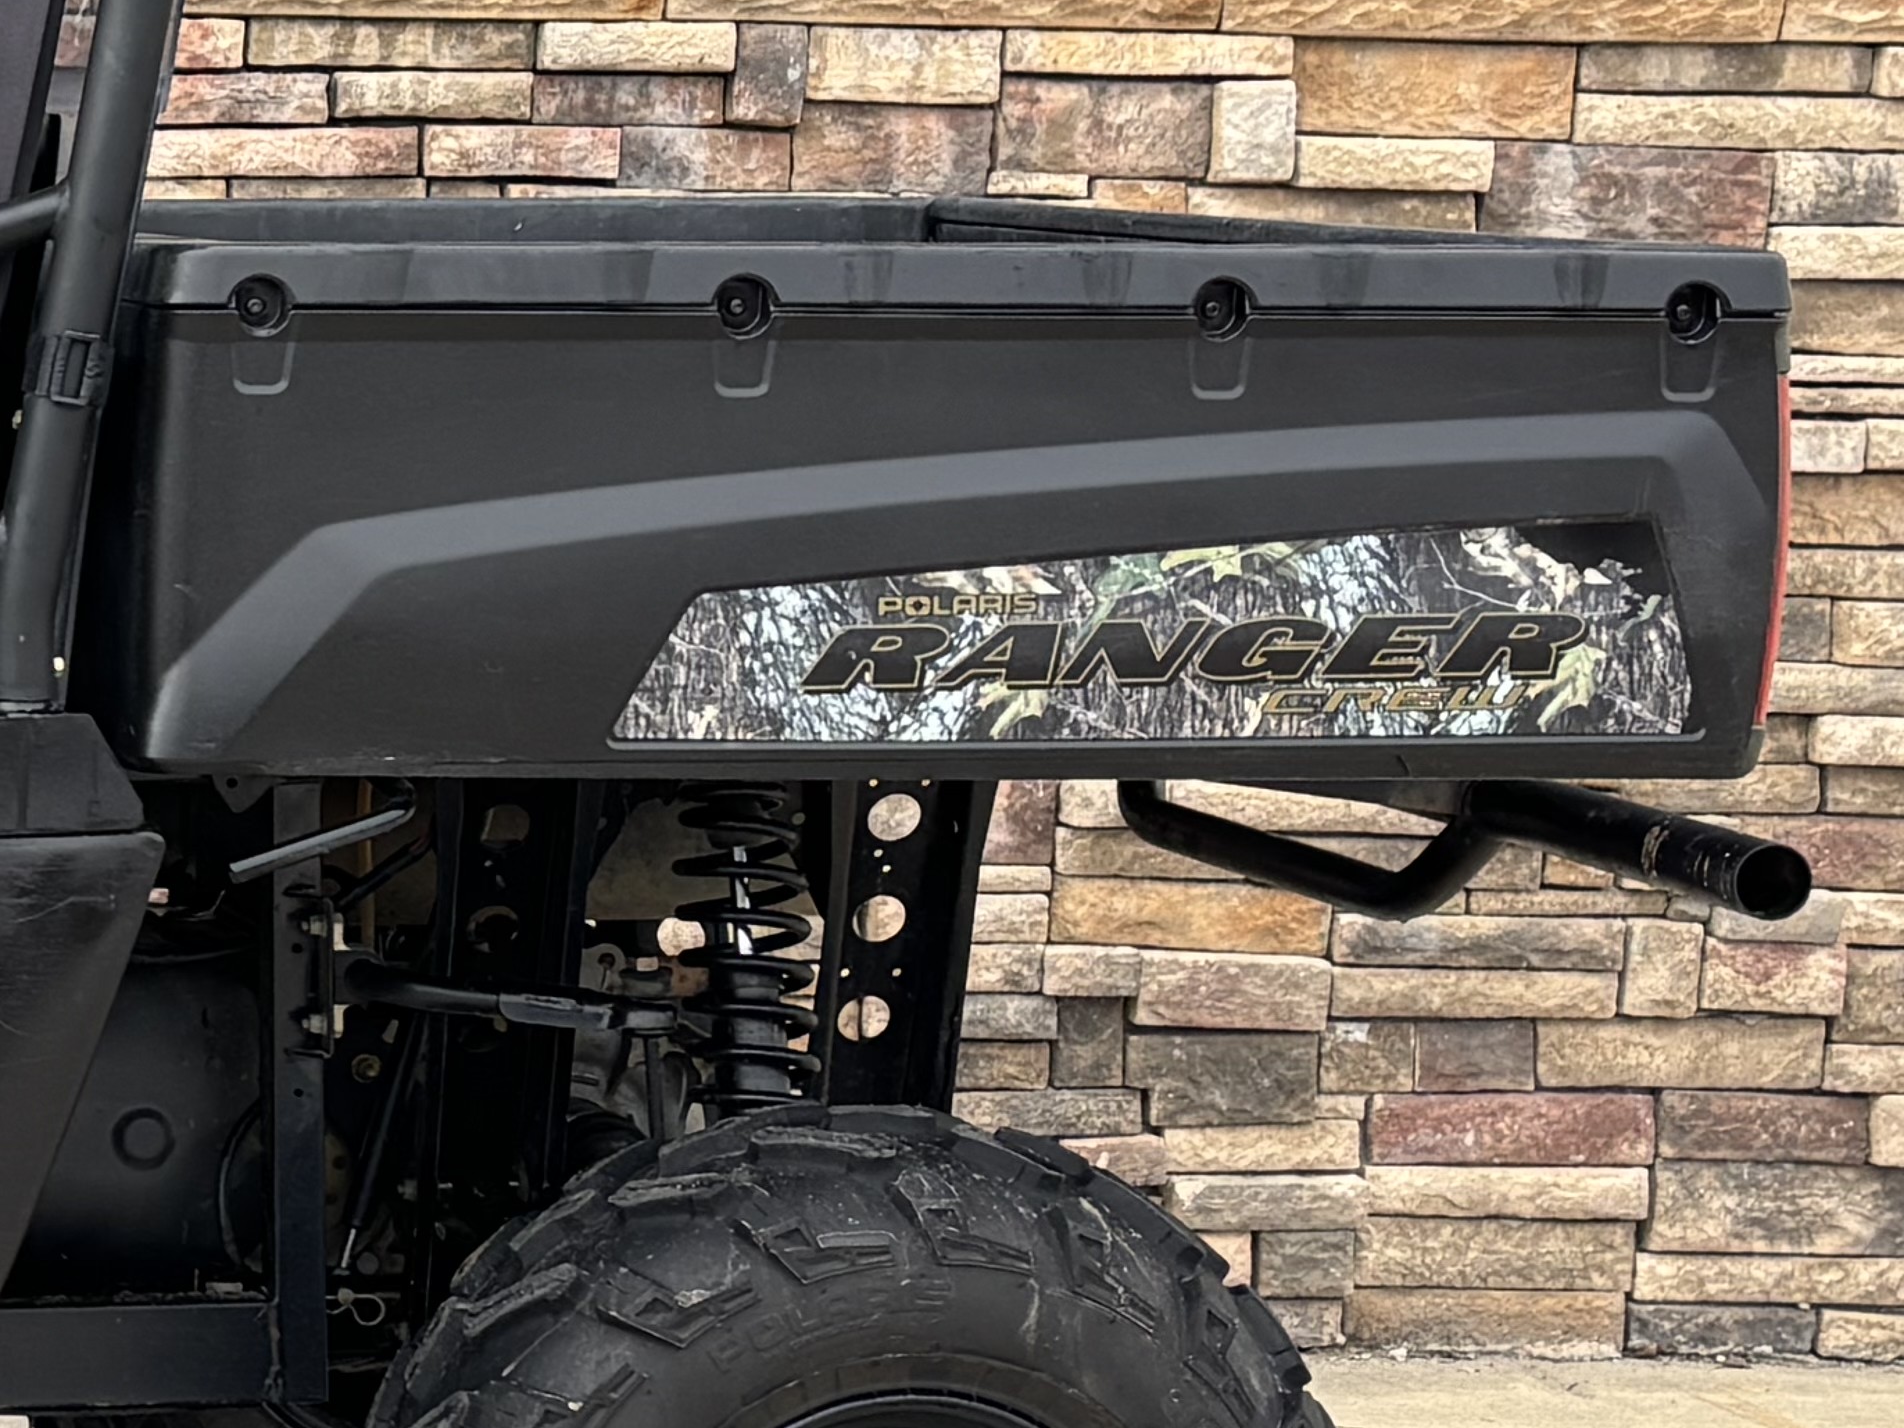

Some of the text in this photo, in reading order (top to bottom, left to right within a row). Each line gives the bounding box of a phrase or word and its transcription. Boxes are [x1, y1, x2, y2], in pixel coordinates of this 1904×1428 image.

[877, 593, 1037, 617] POLARIS
[801, 611, 1591, 693] RANGER
[1262, 683, 1531, 716] CREW
